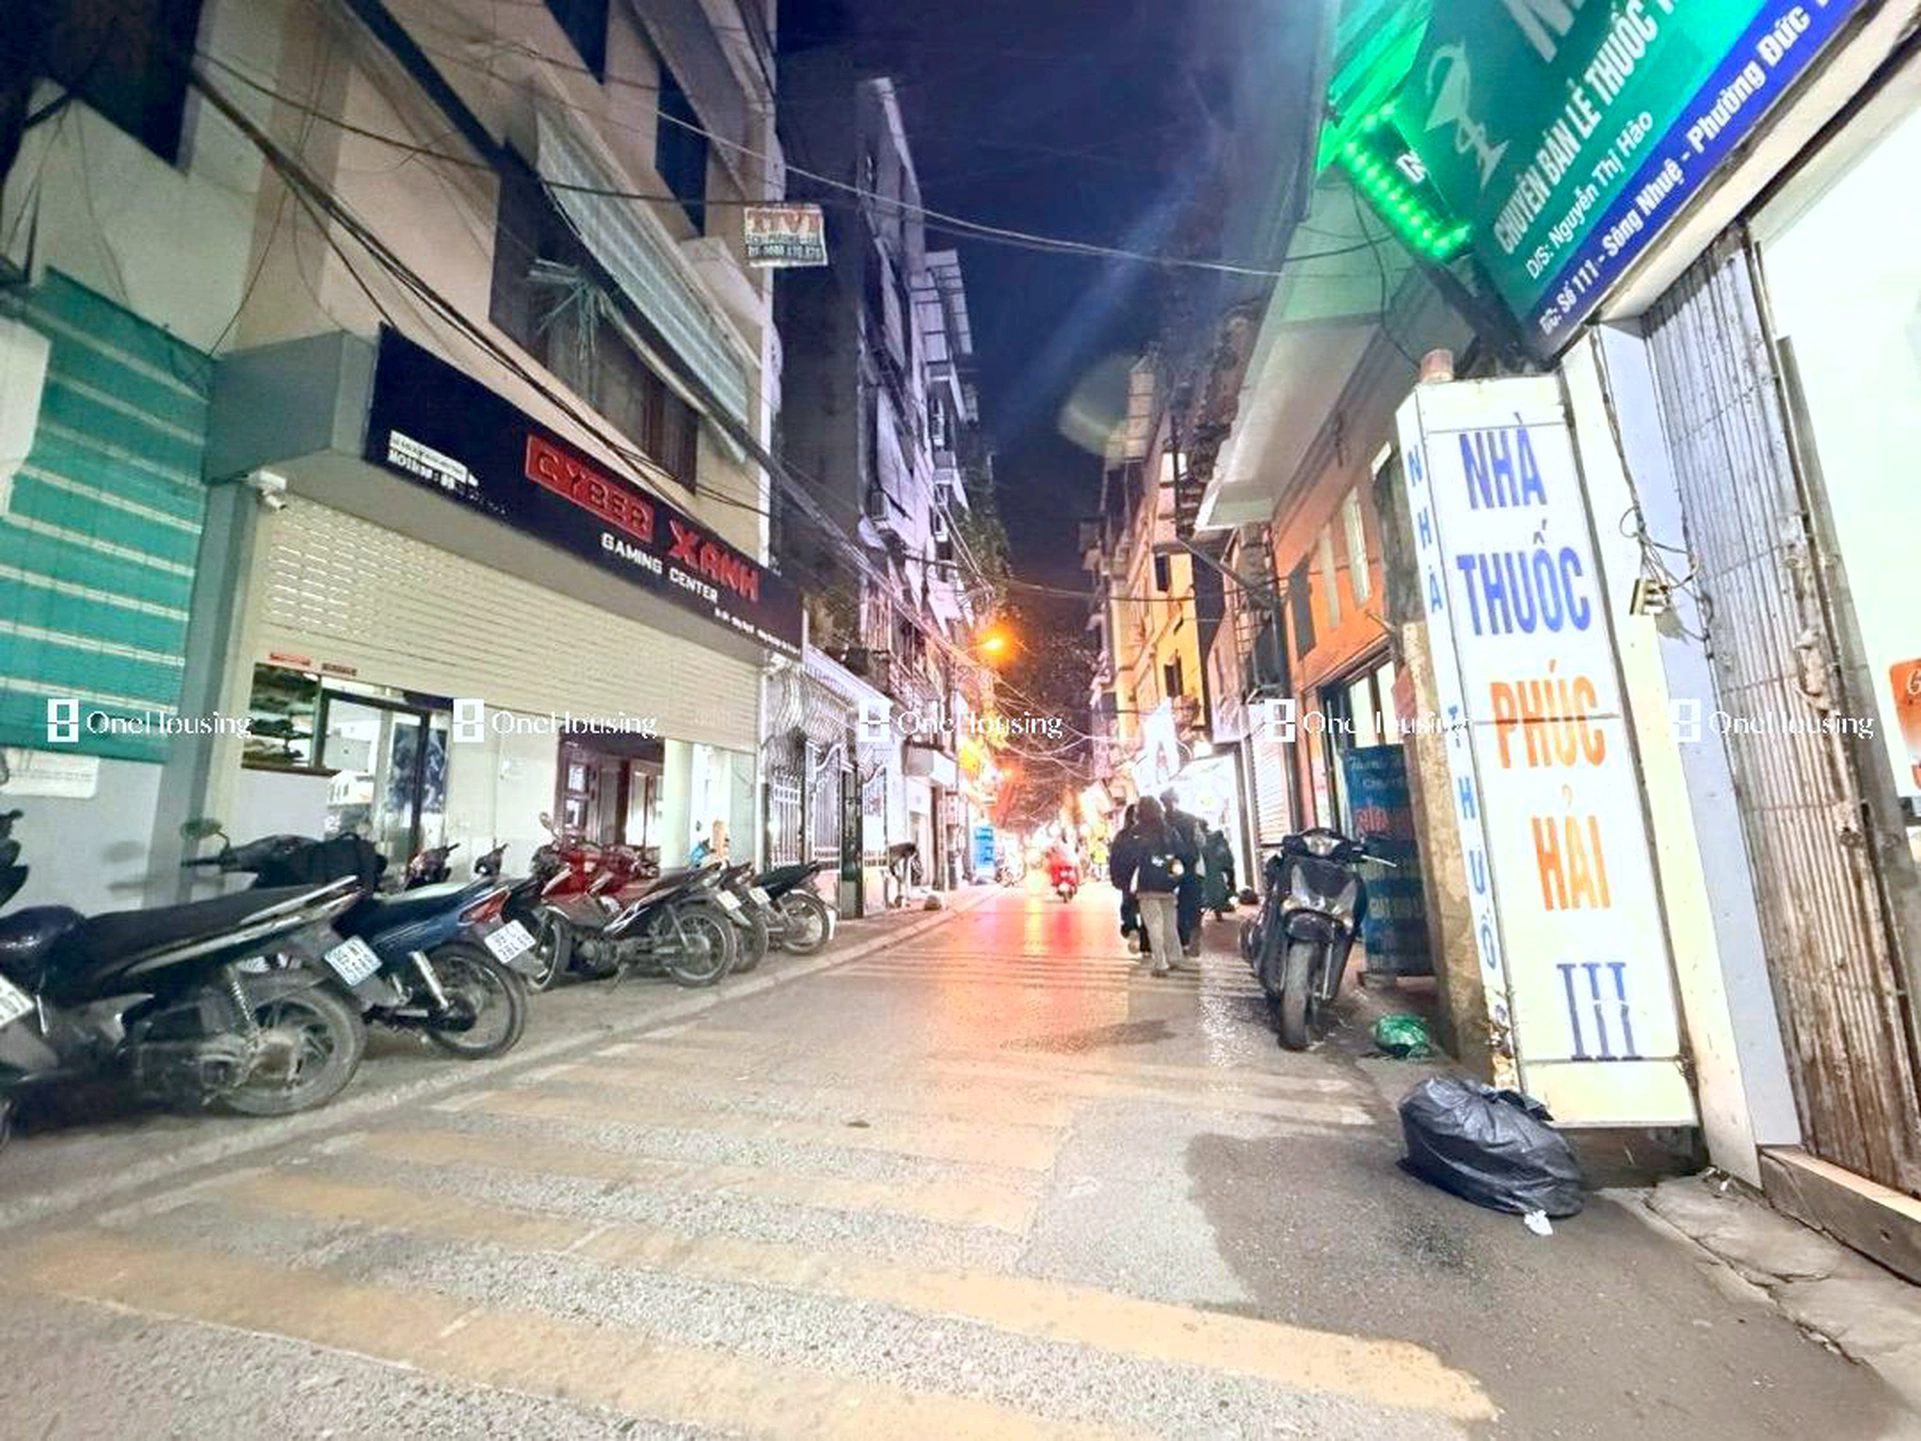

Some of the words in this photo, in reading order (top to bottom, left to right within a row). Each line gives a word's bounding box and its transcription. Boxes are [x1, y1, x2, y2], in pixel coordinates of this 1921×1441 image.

[1548, 182, 1599, 250] Nguyễn
[1591, 147, 1625, 188] Thị
[1572, 259, 1599, 293] 111
[1601, 209, 1644, 258] Sông
[1635, 157, 1685, 216] Nhuệ
[1687, 60, 1766, 153] Phường
[1756, 6, 1811, 67] Đức
[1459, 412, 1547, 510] NHÀ
[538, 449, 652, 533] CYBER
[668, 518, 760, 602] XANH
[600, 531, 663, 576] GAMING
[669, 566, 719, 604] CENTER
[1456, 518, 1592, 636] THUỐC
[1489, 659, 1607, 768] PHÚC
[1532, 784, 1612, 912] HẢI
